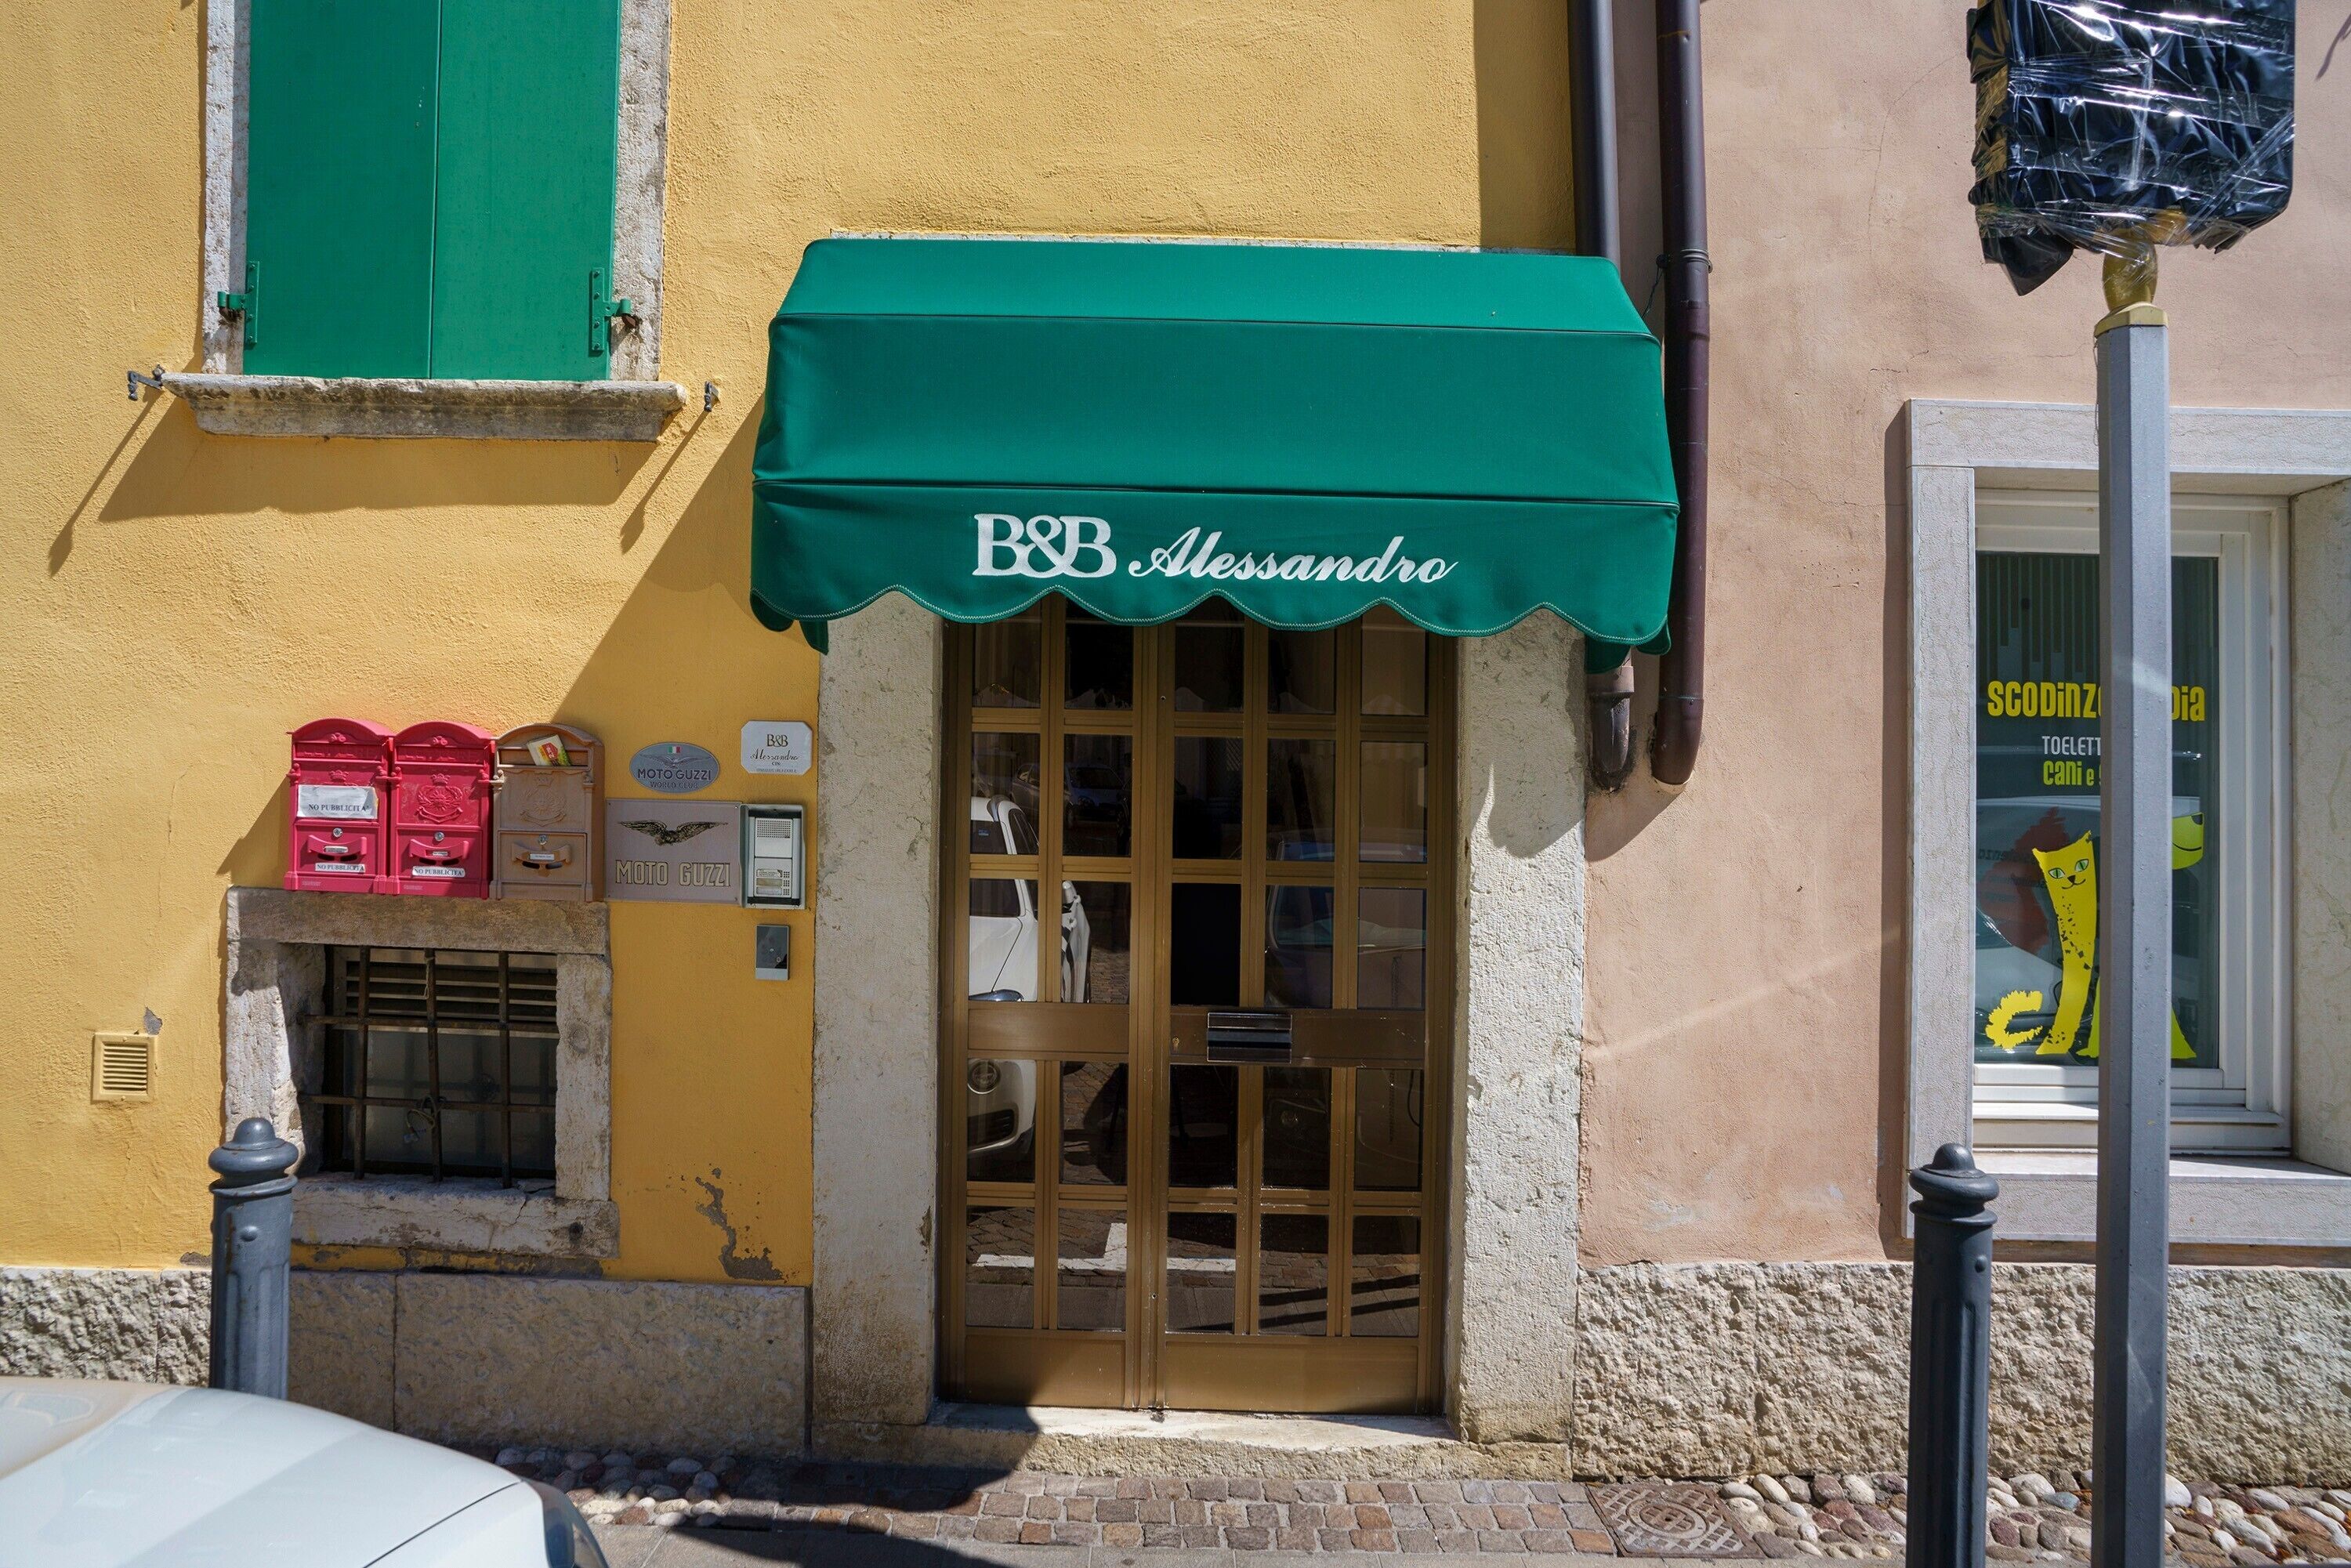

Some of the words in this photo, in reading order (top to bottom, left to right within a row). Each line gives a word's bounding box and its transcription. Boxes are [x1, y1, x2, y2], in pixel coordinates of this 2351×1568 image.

[972, 513, 1117, 578] B&B
[1128, 526, 1459, 583] Alessandro
[766, 733, 788, 747] B&B
[2041, 735, 2101, 755] TOELETT
[750, 748, 799, 761] Alessandro
[638, 769, 673, 780] MOTO
[676, 770, 712, 780] GUZZI
[615, 860, 668, 886] MOTO
[679, 862, 731, 887] GUZZI
